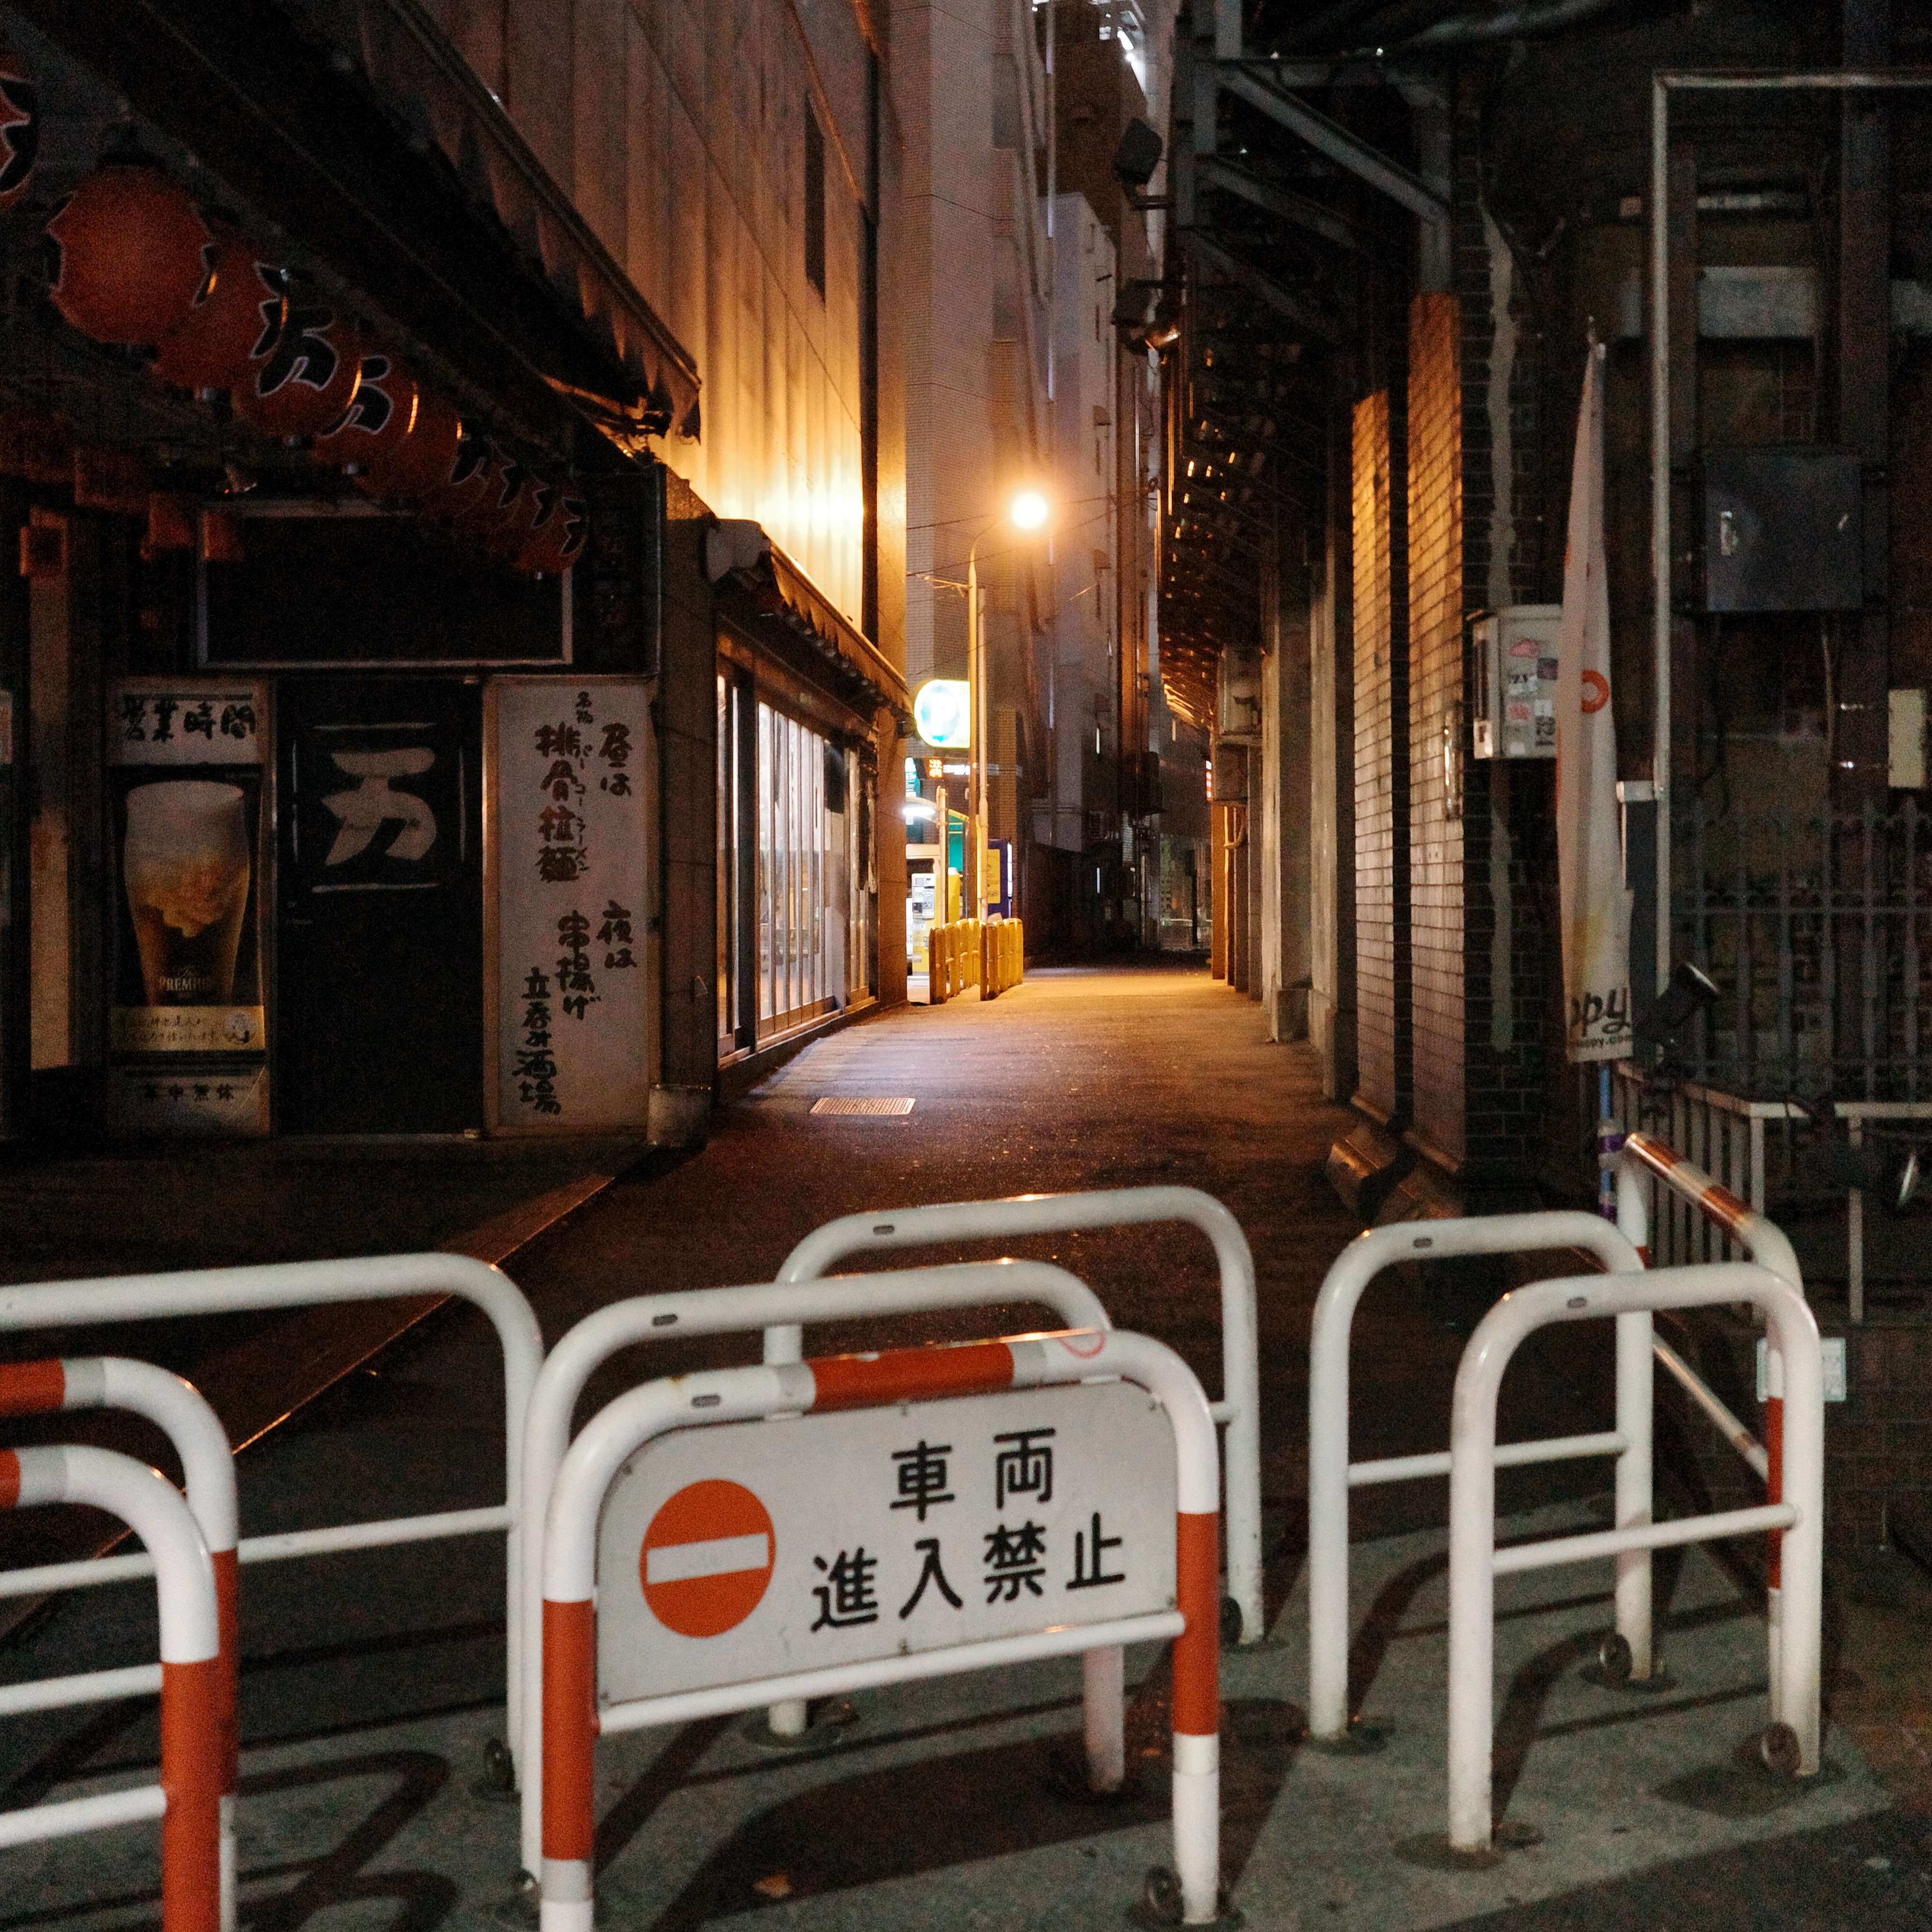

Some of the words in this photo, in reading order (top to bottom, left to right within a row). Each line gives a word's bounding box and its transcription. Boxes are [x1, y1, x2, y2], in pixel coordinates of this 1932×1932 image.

[599, 723, 632, 798] 昼は
[554, 909, 601, 1021] 串揚げ
[596, 899, 638, 968] 夜は
[890, 1428, 1055, 1521] 車両
[811, 1512, 1126, 1634] 進入禁止
